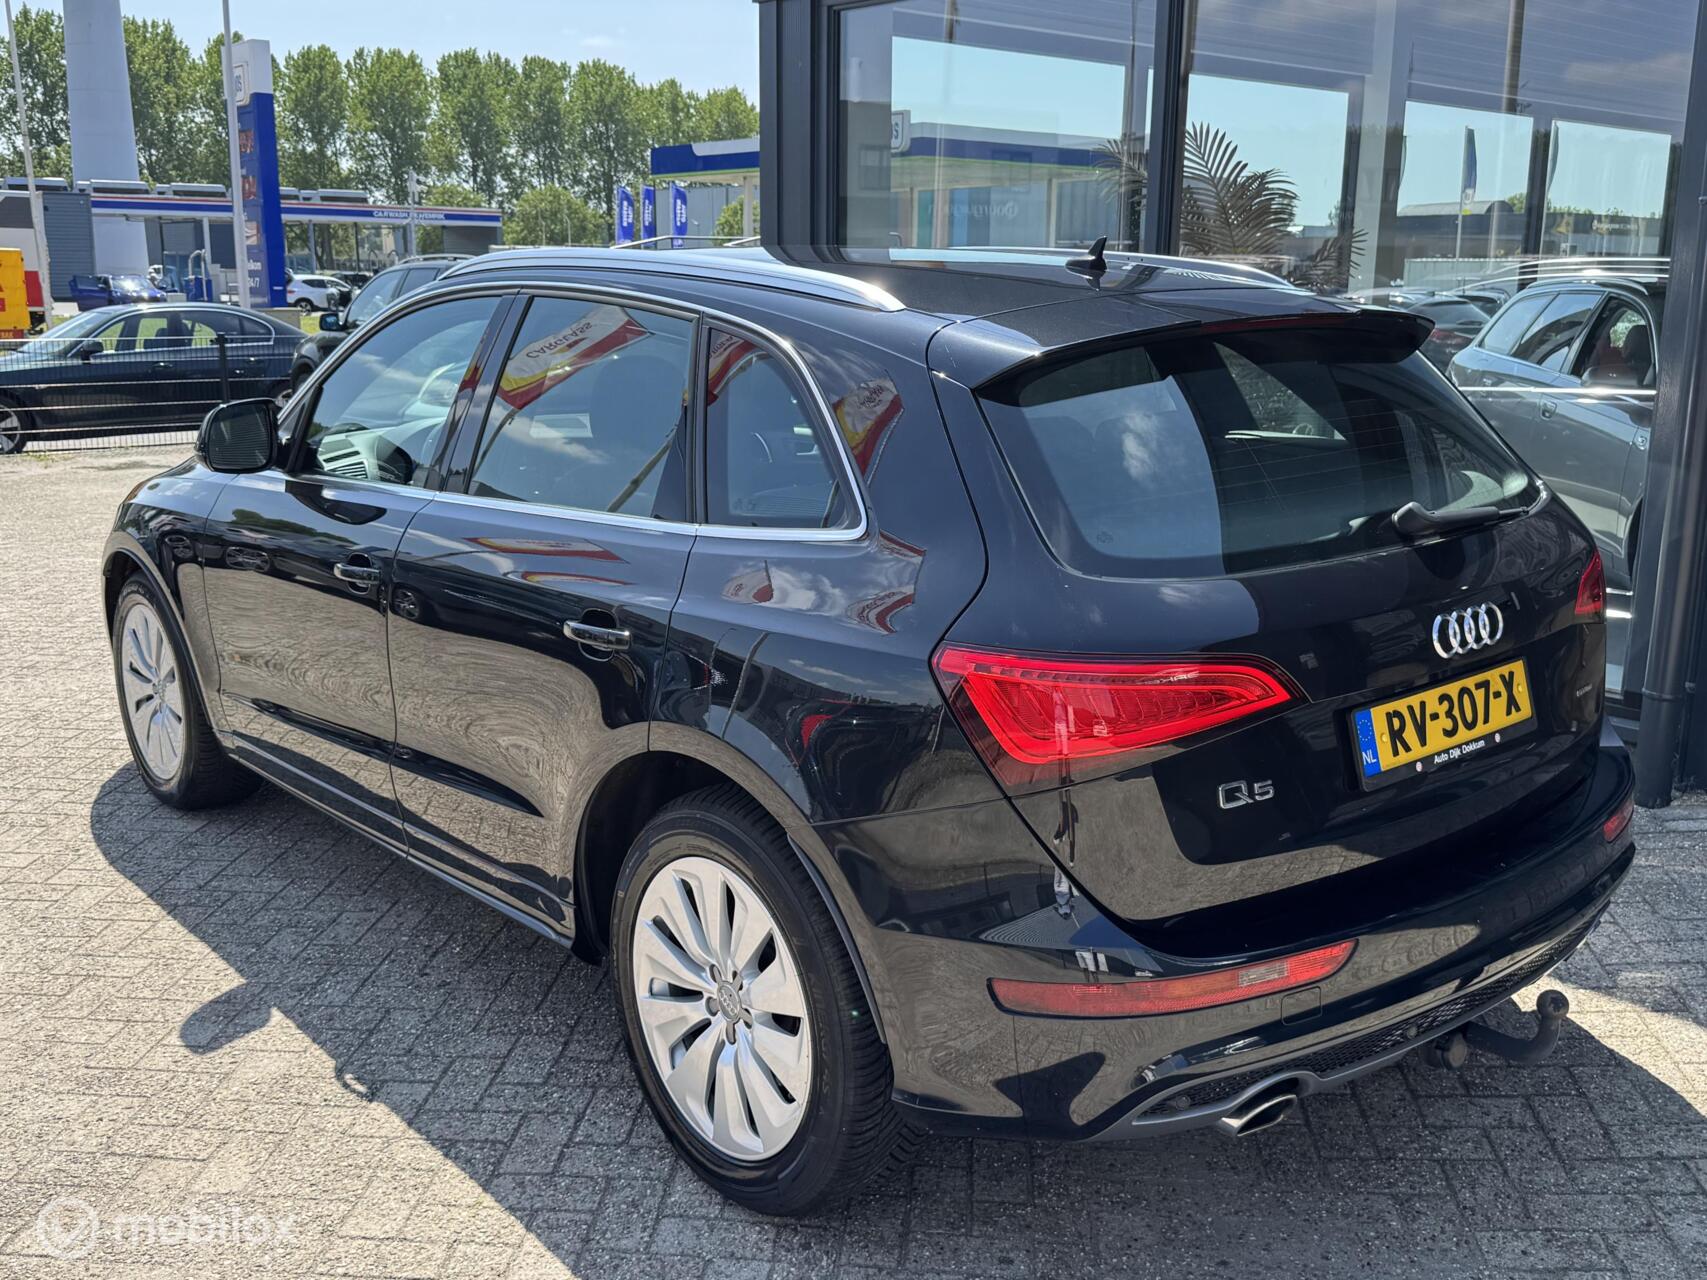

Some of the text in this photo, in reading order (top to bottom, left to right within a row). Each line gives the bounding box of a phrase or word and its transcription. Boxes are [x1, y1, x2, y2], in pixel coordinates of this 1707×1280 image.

[1385, 671, 1522, 758] RV-307-X
[1362, 751, 1377, 766] NL
[1433, 738, 1486, 764] Auto Dijk Dokkum
[1218, 779, 1275, 809] Q5
